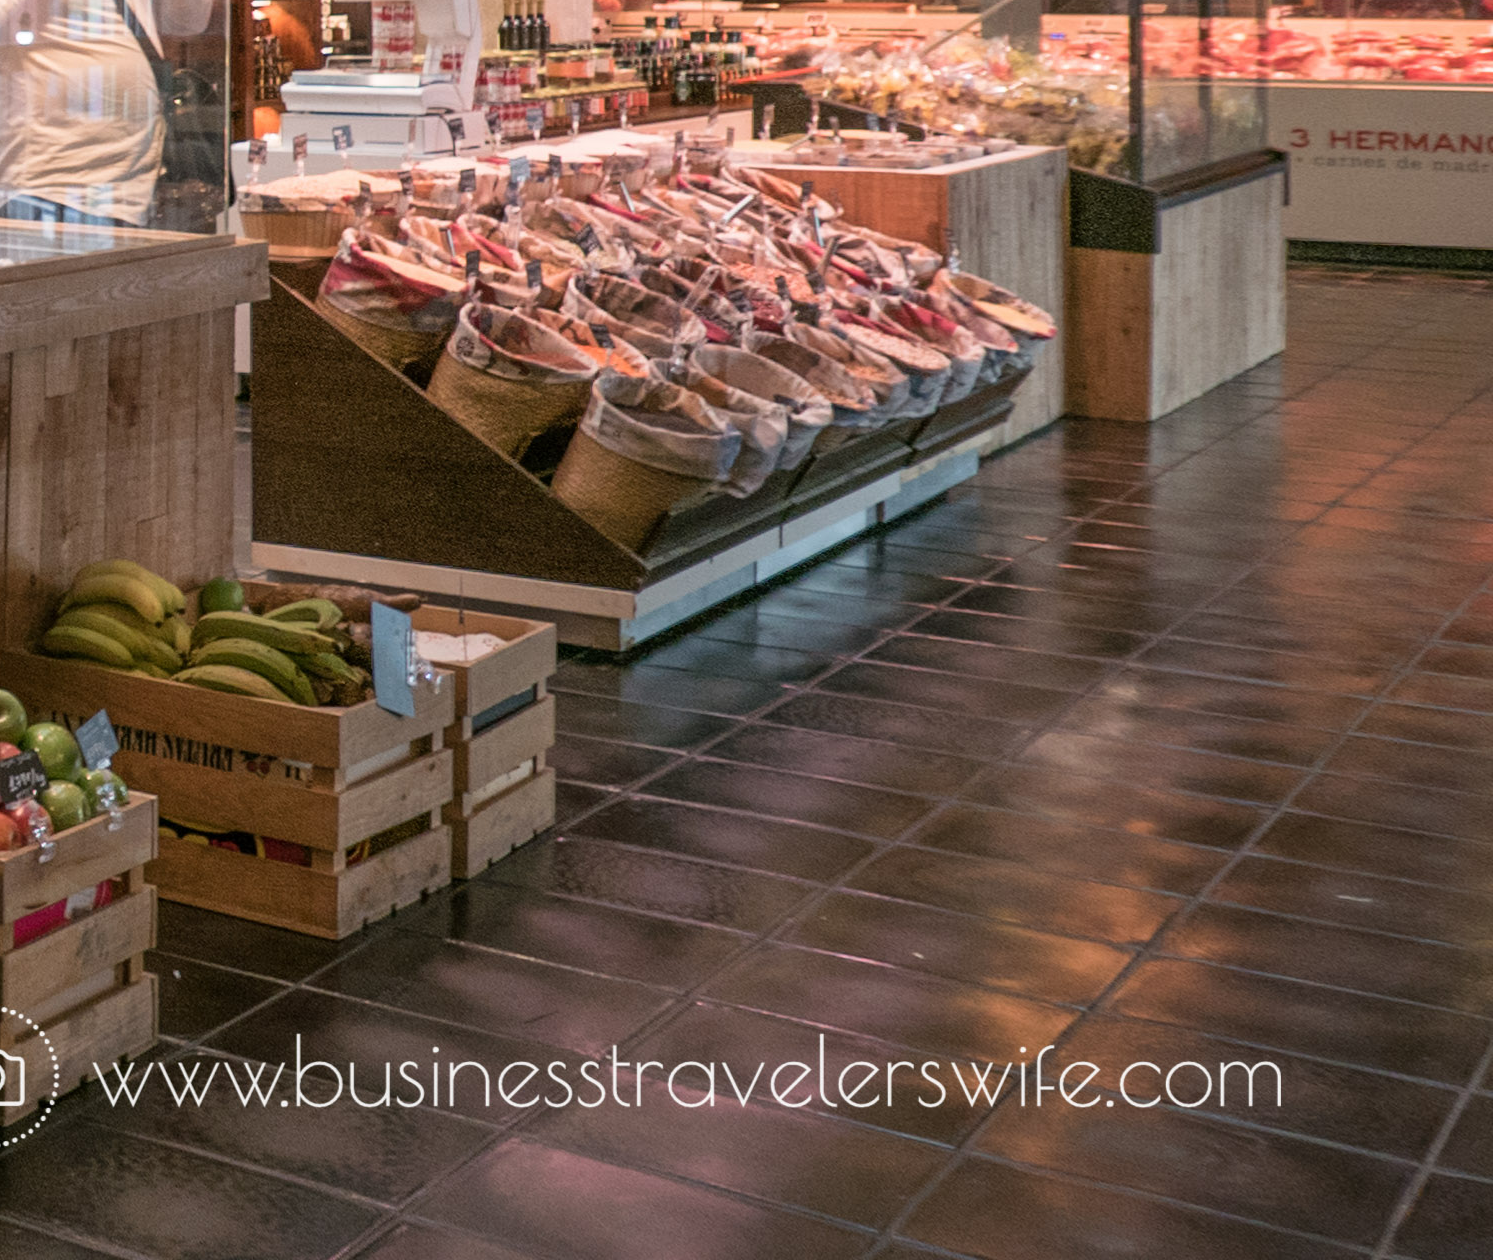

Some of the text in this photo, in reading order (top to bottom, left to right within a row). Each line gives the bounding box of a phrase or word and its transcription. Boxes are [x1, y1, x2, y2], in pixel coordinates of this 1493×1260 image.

[1289, 128, 1311, 148] 3
[1313, 155, 1387, 169] carnes
[1396, 156, 1423, 171] de
